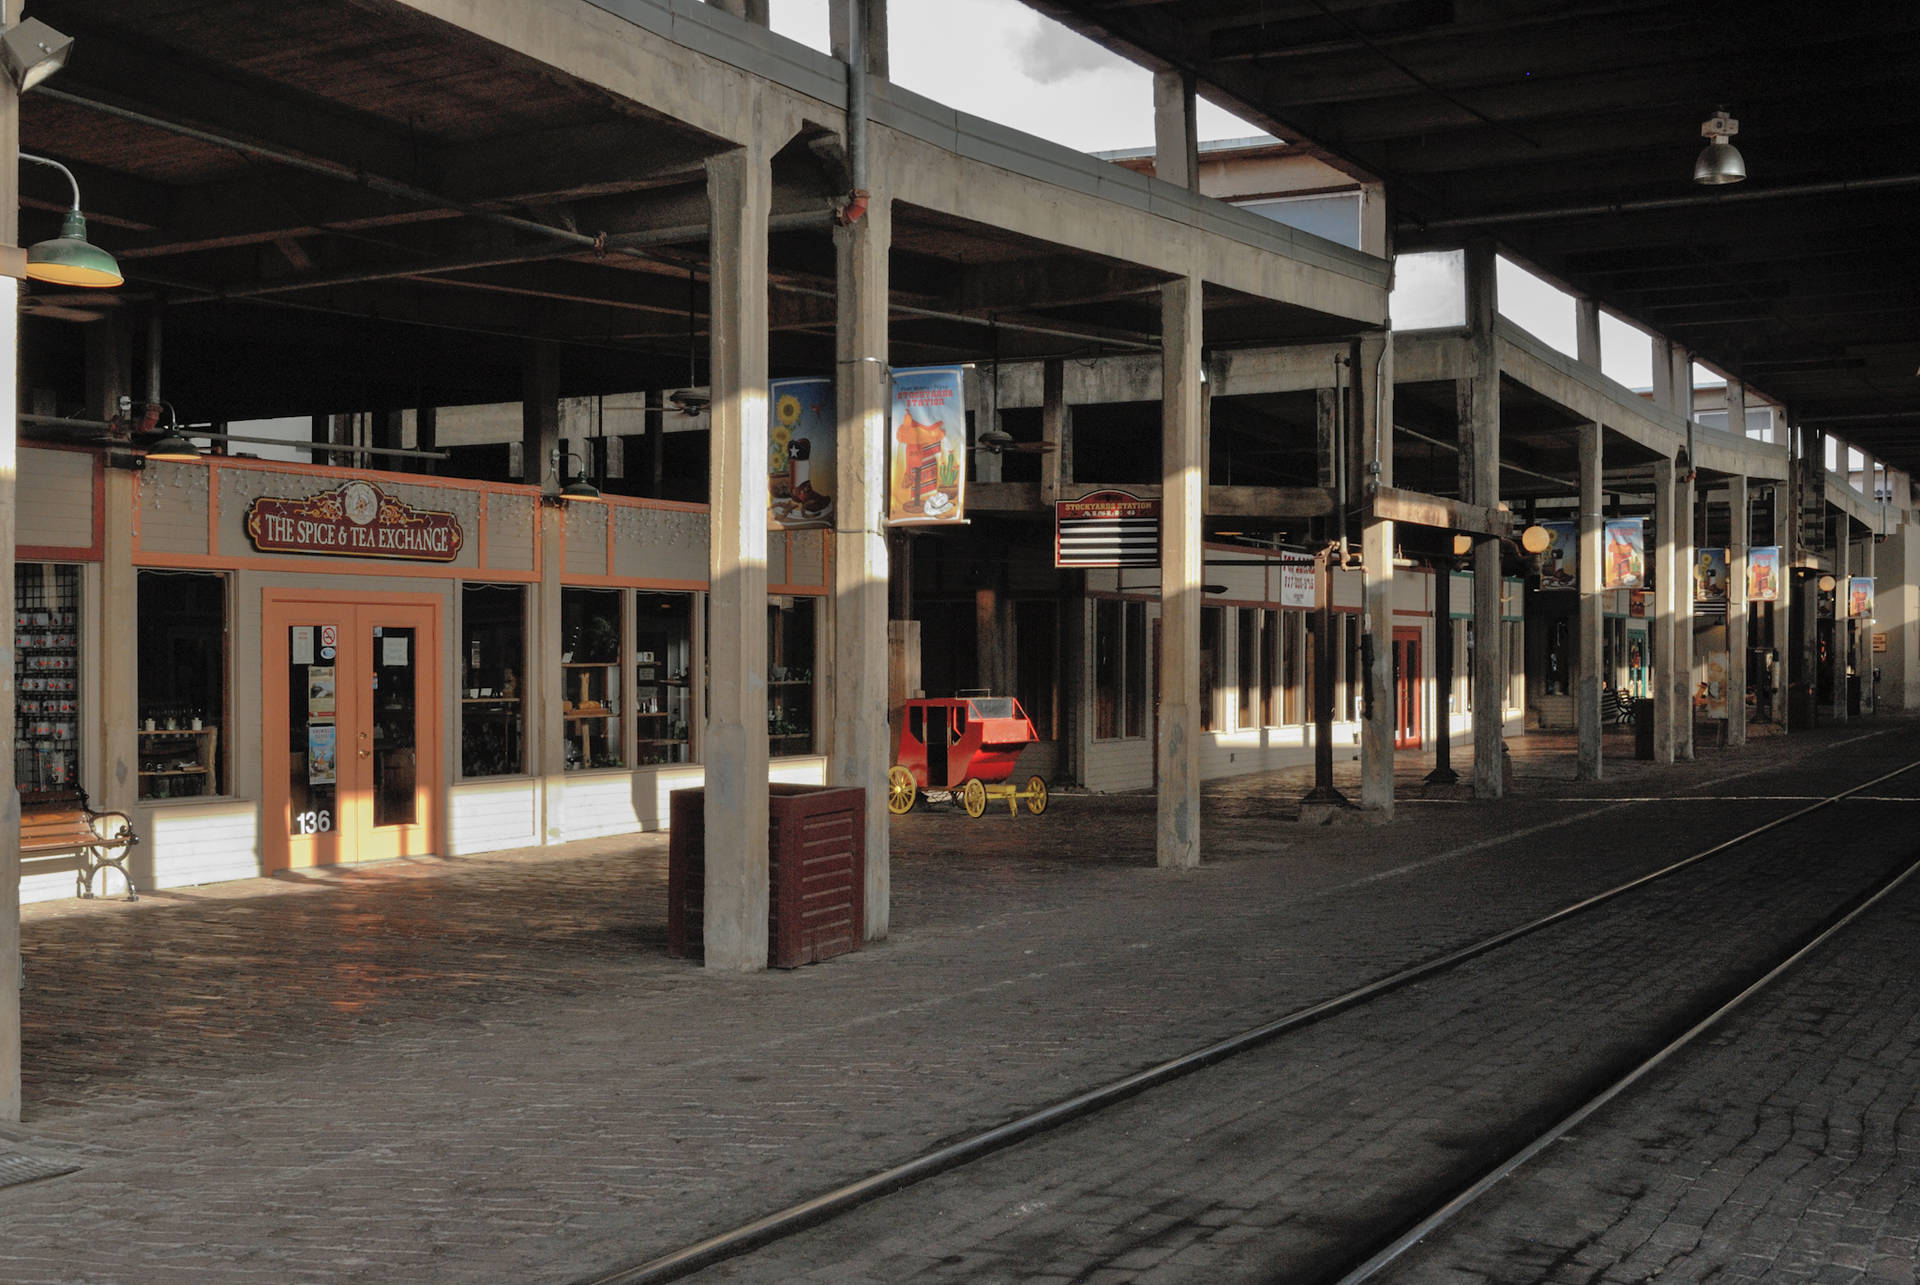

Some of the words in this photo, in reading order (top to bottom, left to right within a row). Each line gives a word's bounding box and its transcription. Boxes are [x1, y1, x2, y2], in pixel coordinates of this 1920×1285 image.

[897, 389, 953, 400] STOCKYARDS
[906, 398, 945, 408] STATION
[1065, 503, 1118, 511] STOCKYARDS
[1119, 502, 1152, 510] STATION
[266, 514, 295, 543] THE
[297, 520, 336, 546] SPICE
[338, 528, 348, 546] &
[350, 526, 376, 548] TEA
[378, 526, 449, 553] EXCHANGE
[296, 809, 331, 835] 136
